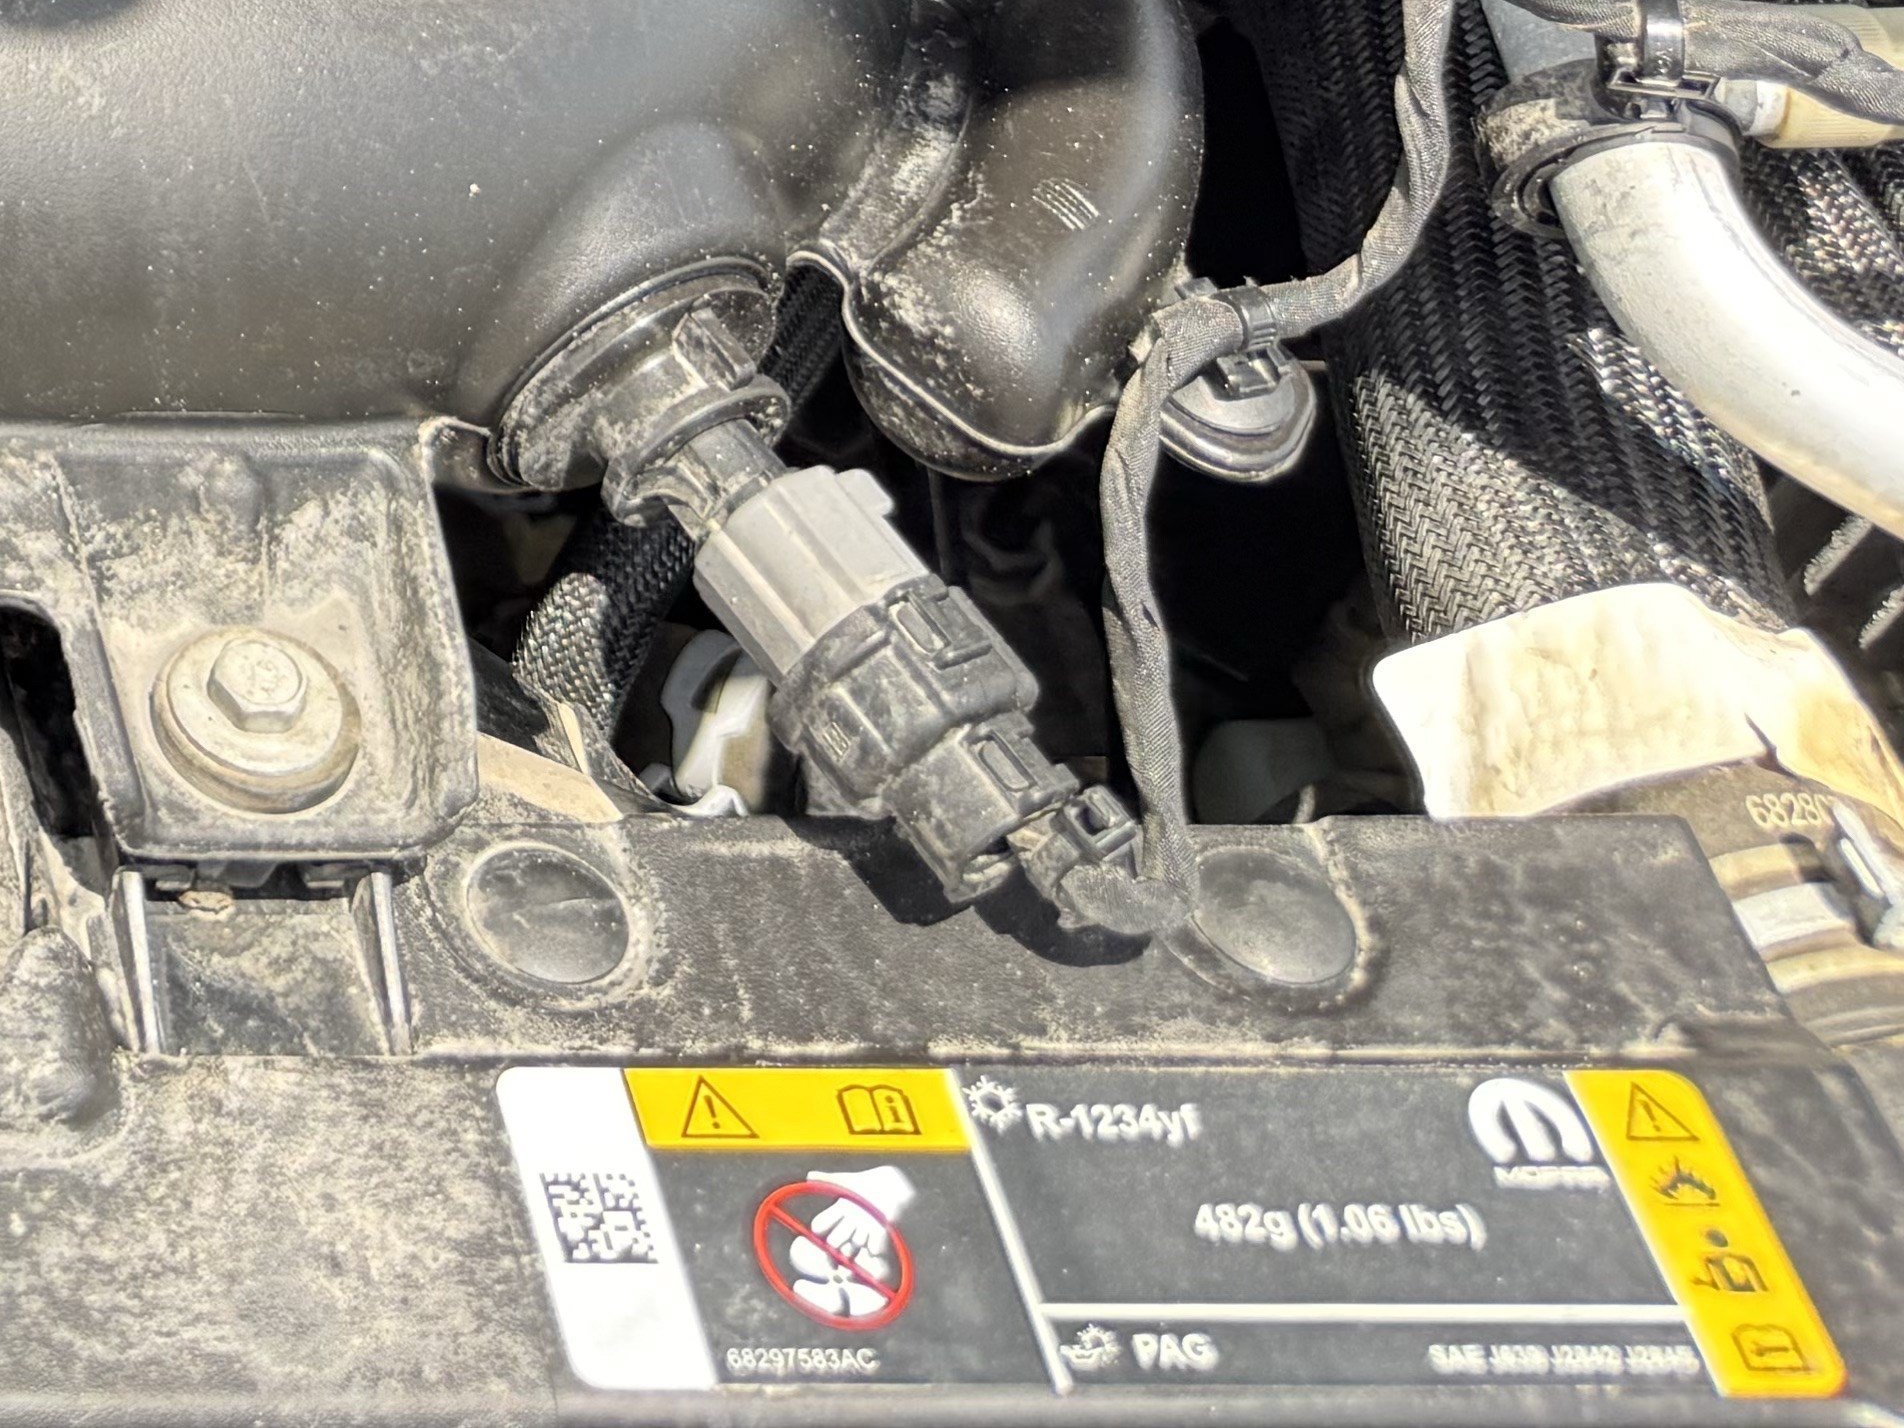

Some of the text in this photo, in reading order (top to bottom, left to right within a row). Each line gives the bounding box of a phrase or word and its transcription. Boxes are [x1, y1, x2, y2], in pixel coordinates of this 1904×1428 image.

[1025, 1102, 1202, 1147] R-1234yf
[1195, 1202, 1487, 1253] 482g (1.06 lbs)
[725, 1347, 881, 1376] 68297583AC
[1132, 1331, 1220, 1370] PAG
[1428, 1343, 1489, 1375] SAE
